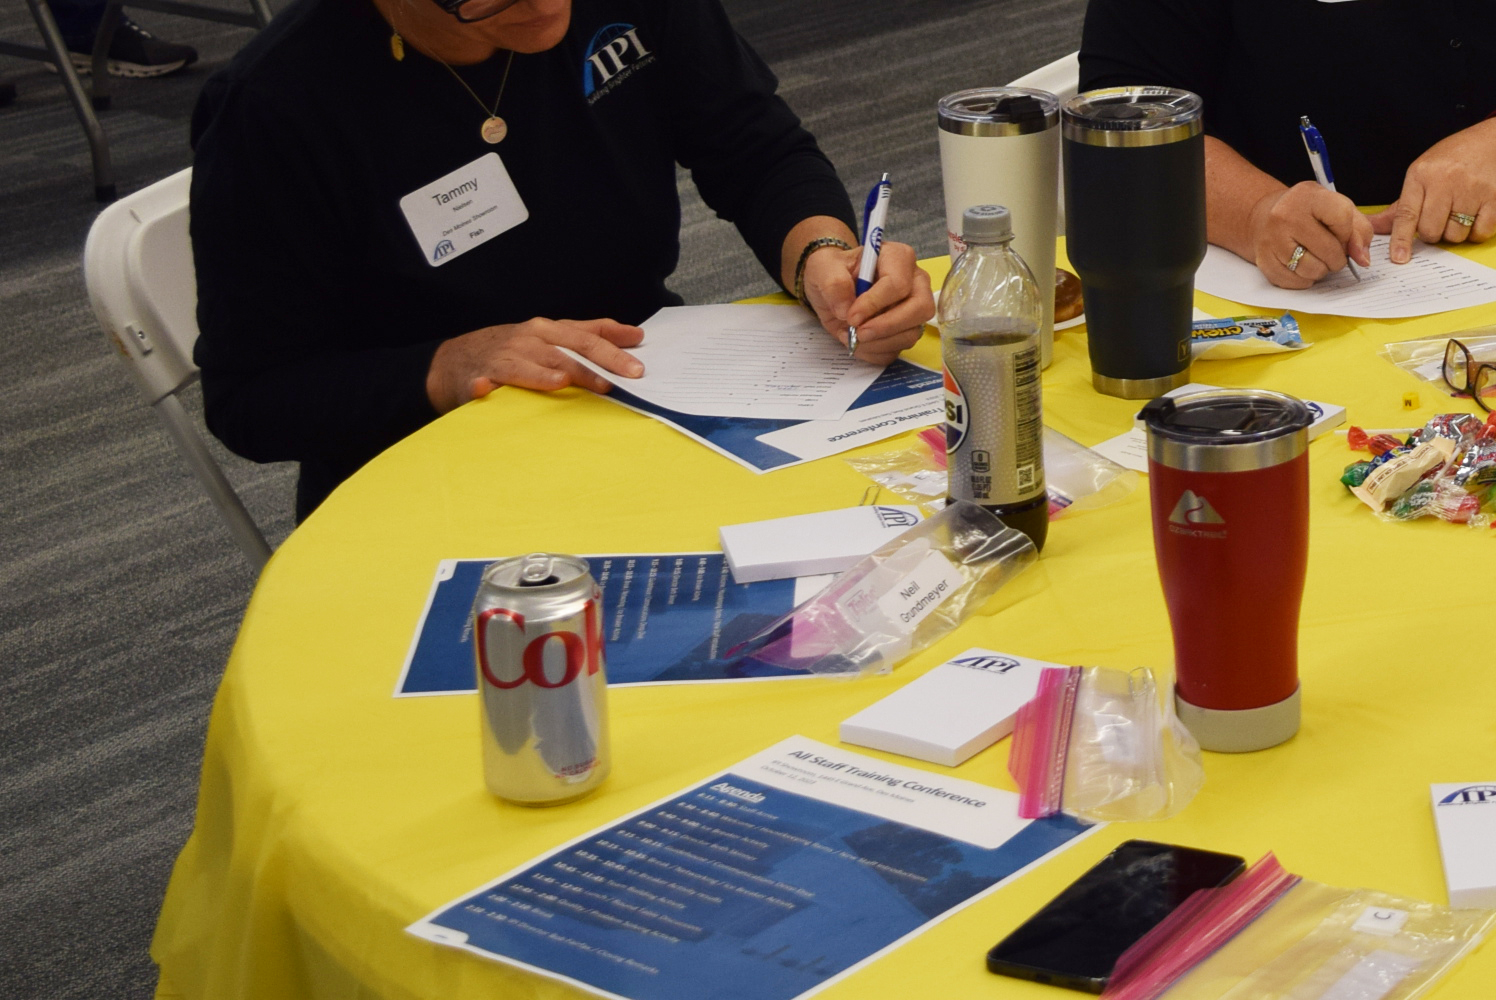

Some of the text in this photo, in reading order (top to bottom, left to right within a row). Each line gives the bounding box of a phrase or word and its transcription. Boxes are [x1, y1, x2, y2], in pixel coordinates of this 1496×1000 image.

[587, 27, 653, 85] IPI
[432, 178, 478, 206] Tammy
[469, 228, 485, 239] Fish
[824, 417, 898, 444] Conference
[881, 512, 910, 528] IPI
[900, 581, 921, 600] Neil
[900, 579, 949, 623] Grundmeyer
[477, 598, 606, 690] Cok
[970, 658, 1017, 673] IPI
[788, 749, 987, 809] All Staff Training Conference
